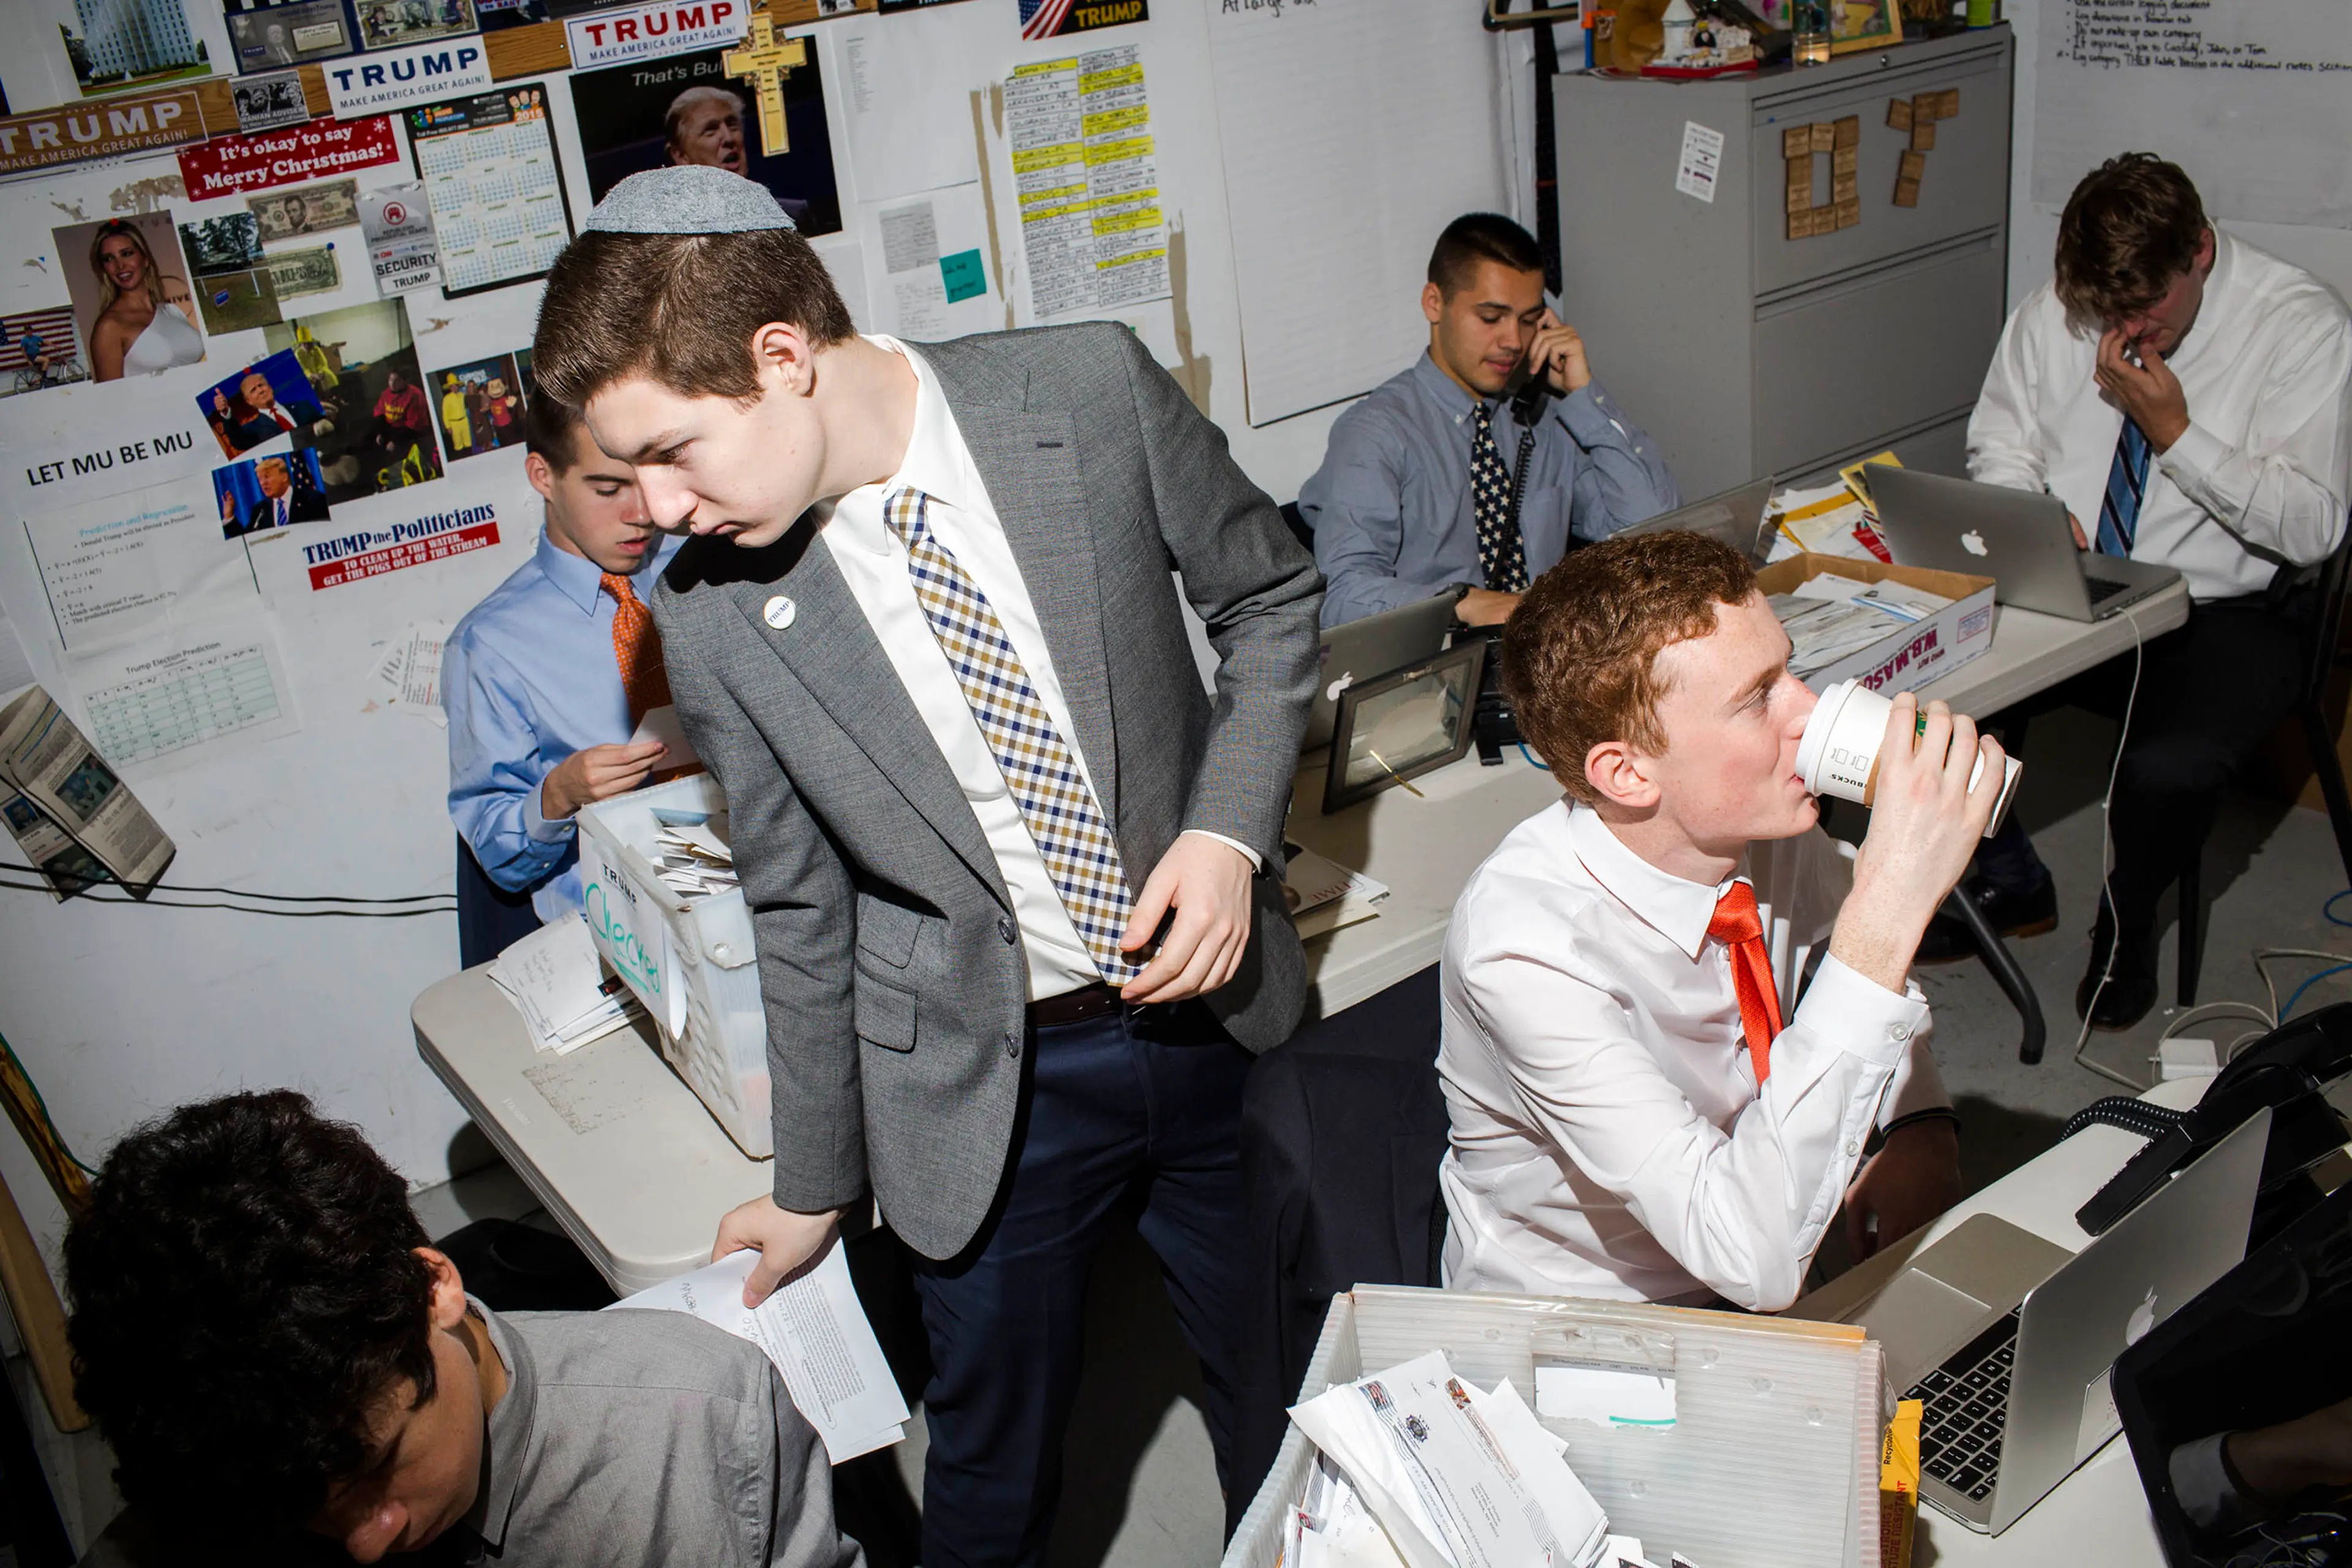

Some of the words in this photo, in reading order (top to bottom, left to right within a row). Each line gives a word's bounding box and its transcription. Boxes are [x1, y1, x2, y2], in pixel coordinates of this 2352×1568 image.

[586, 2, 733, 47] TRUMP
[1075, 1, 1142, 28] TRUMP
[589, 47, 617, 60] MAKE
[621, 39, 666, 55] AMERICA
[669, 32, 700, 46] GREAT
[703, 26, 736, 40] AGAIN!
[2244, 43, 2266, 55] Tom
[332, 48, 479, 91] TRUMP
[631, 66, 688, 86] That's
[340, 98, 368, 109] MAKE
[371, 87, 416, 103] AMERICA
[418, 80, 451, 94] GREAT
[452, 75, 485, 89] AGAIN!
[0, 102, 182, 154] TRUMP
[516, 108, 544, 121] 2015
[0, 157, 39, 170] MAKE
[40, 146, 100, 163] AMERICA
[102, 138, 141, 154] GREAT
[145, 129, 187, 146] AGAIN!
[219, 146, 250, 161] It's
[254, 137, 298, 155] okay
[301, 132, 322, 145] to
[325, 126, 353, 143] say
[203, 167, 268, 190] Merry
[273, 142, 385, 176] Christmas!
[376, 252, 436, 276] SECURITY
[393, 272, 431, 288] TRUMP
[26, 461, 65, 486] LET
[72, 450, 115, 476] MU
[119, 442, 148, 464] BE
[153, 430, 194, 457] MU
[301, 531, 374, 565] TRUMP
[372, 530, 393, 544] the
[390, 502, 496, 541] Politicians
[322, 573, 343, 586] GET
[344, 567, 365, 580] THE
[366, 561, 391, 575] PIGS
[392, 555, 413, 568] OUT
[413, 551, 428, 562] OF
[429, 546, 449, 559] THE
[449, 537, 488, 554] STREAM
[342, 559, 358, 571] TO
[359, 552, 389, 566] CLEAN
[391, 548, 404, 558] UP
[405, 543, 426, 554] THE
[428, 533, 464, 549] WATER,
[768, 601, 789, 622] TRUMP
[125, 660, 152, 675] Trump
[151, 652, 183, 667] Election
[181, 639, 221, 657] Prediction
[1930, 647, 1946, 664] WHO
[1832, 774, 1867, 788] BUCKS
[603, 862, 637, 903] TRUMP
[1308, 882, 1351, 902] TIME
[1893, 1480, 1907, 1536] RESISTANT
